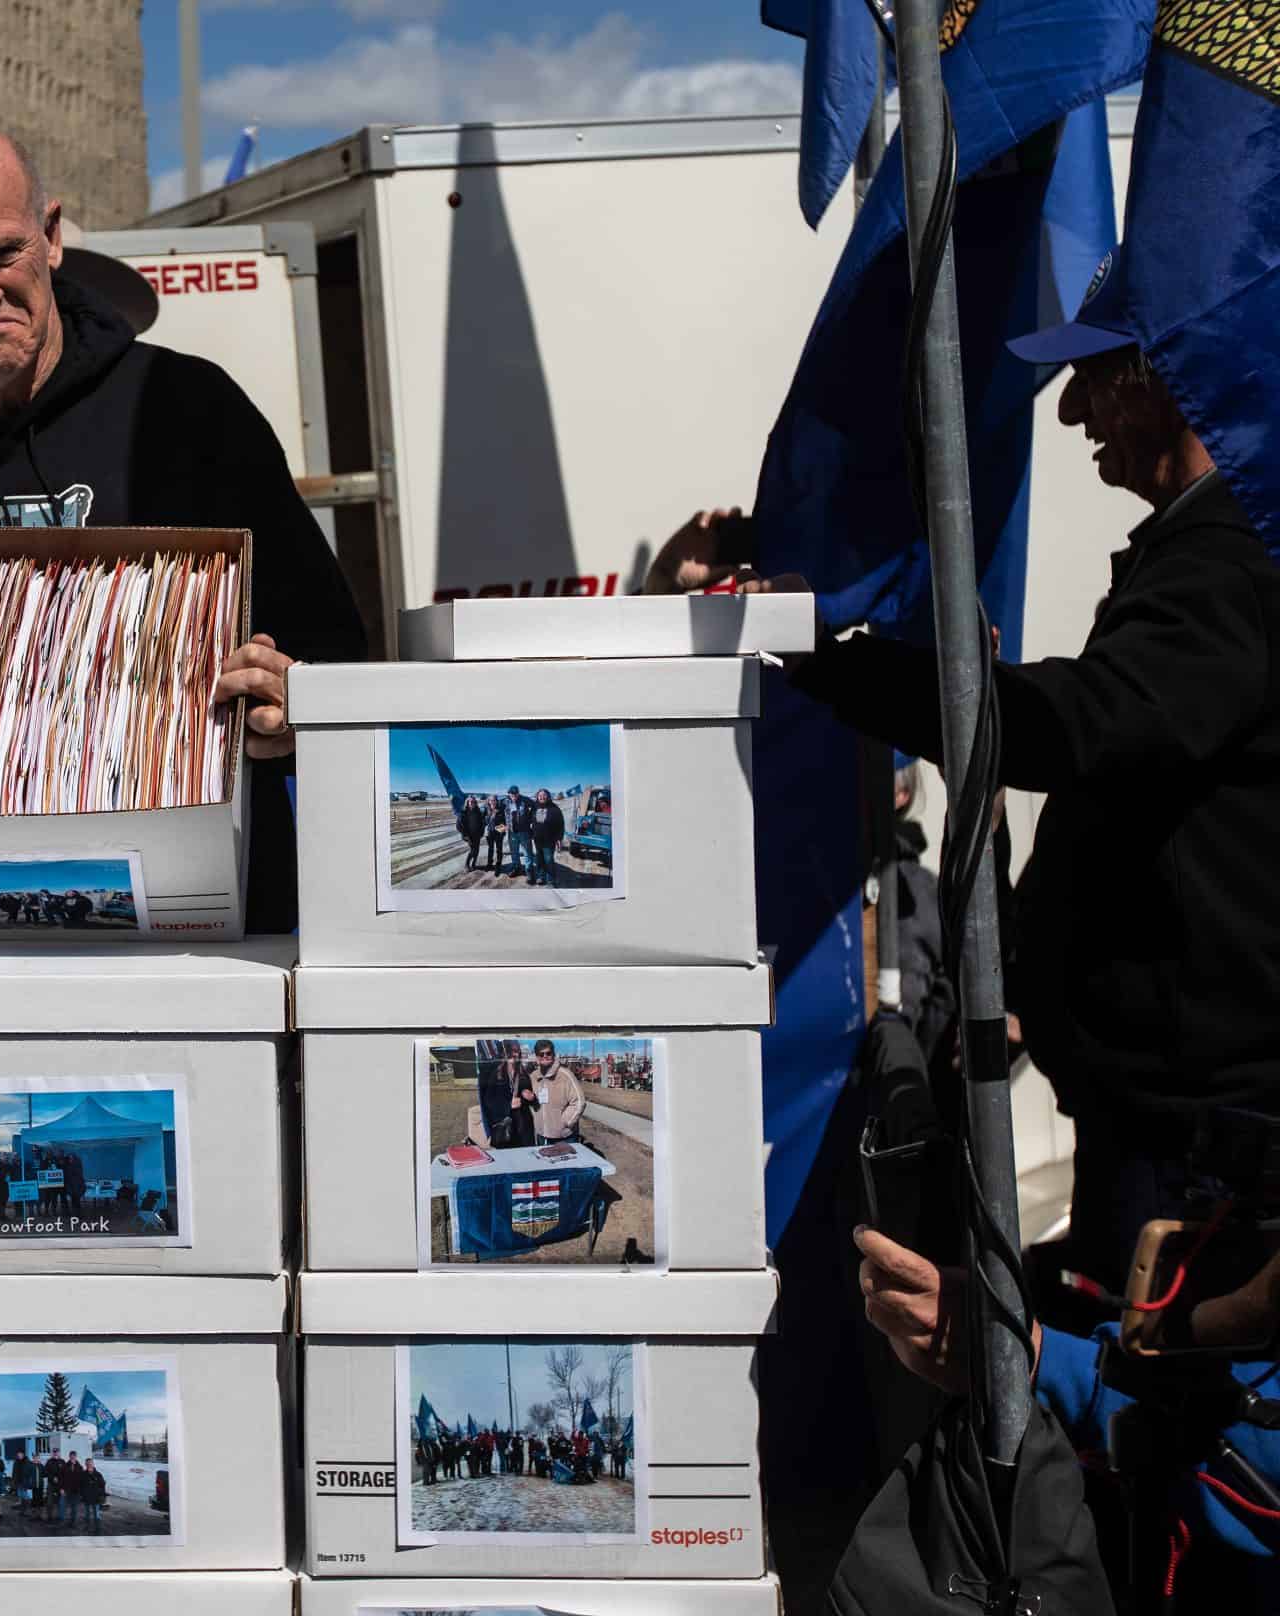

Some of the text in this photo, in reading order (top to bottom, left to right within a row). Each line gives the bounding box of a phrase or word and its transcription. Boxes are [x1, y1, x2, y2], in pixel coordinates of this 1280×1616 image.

[150, 920, 213, 932] taples
[69, 1215, 110, 1232] Park
[316, 1470, 396, 1488] STORAGE
[651, 1527, 729, 1548] staples
[338, 1553, 366, 1563] 13715
